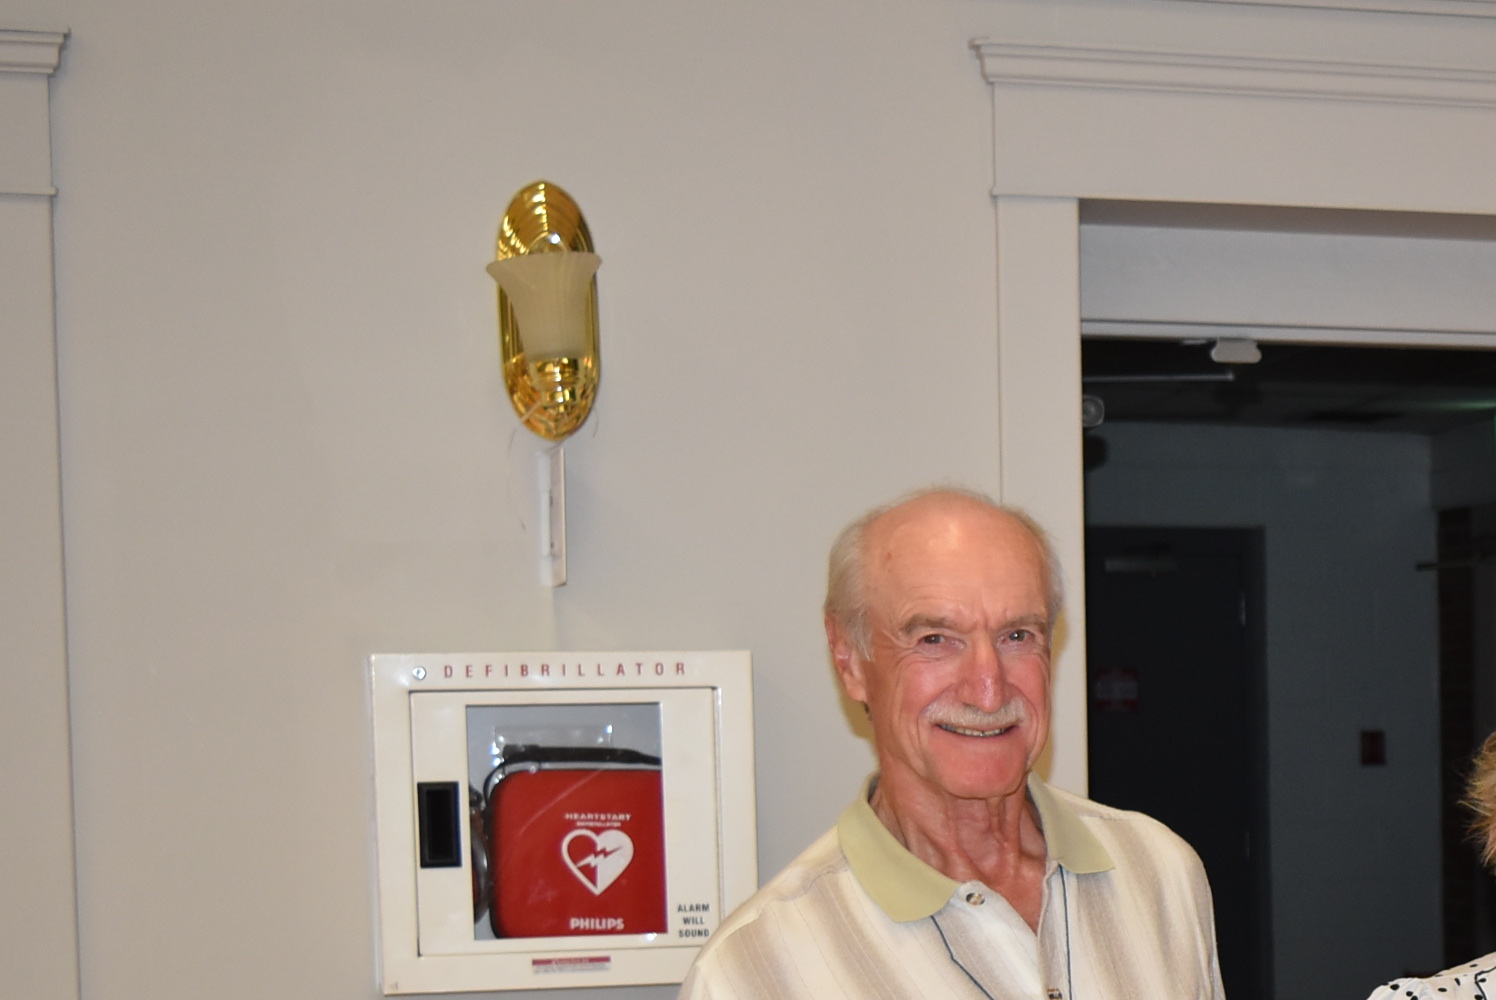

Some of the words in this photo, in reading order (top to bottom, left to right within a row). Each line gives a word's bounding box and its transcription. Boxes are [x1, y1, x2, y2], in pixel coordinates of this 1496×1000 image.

[444, 662, 685, 678] DEFIBRILLATOR
[677, 903, 710, 913] ALARM
[569, 917, 625, 930] PHILIPS
[682, 916, 705, 926] WILL
[678, 928, 710, 938] SOUND
